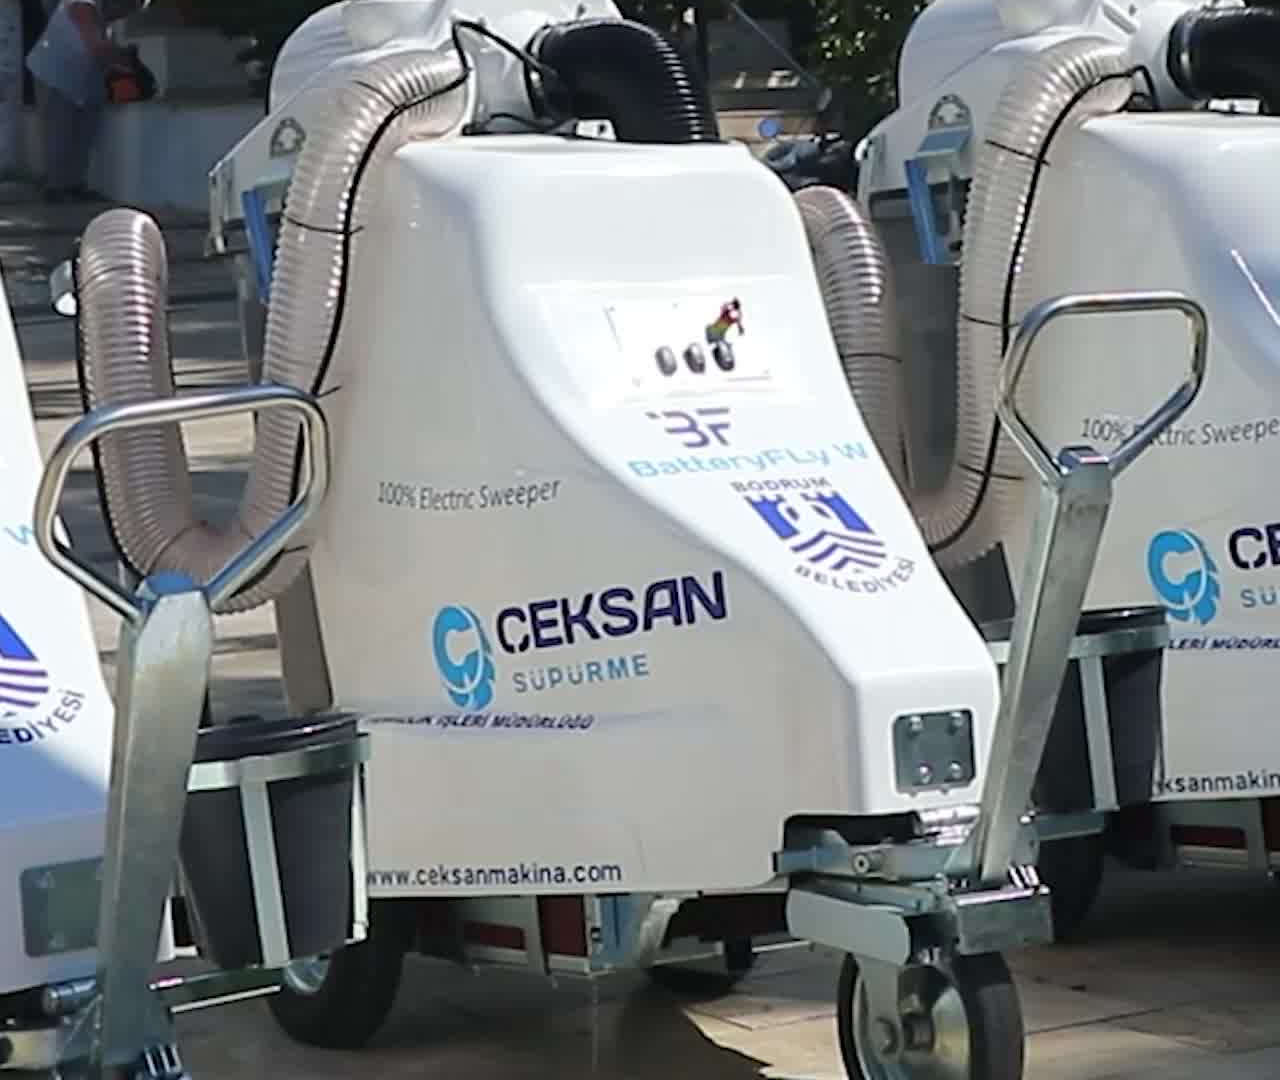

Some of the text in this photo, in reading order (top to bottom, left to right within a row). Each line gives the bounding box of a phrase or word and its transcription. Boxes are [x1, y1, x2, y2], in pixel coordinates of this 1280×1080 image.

[730, 477, 832, 494] BODRUM
[377, 479, 560, 511] 100% Electric Sweeper
[1170, 635, 1207, 649] LERİ
